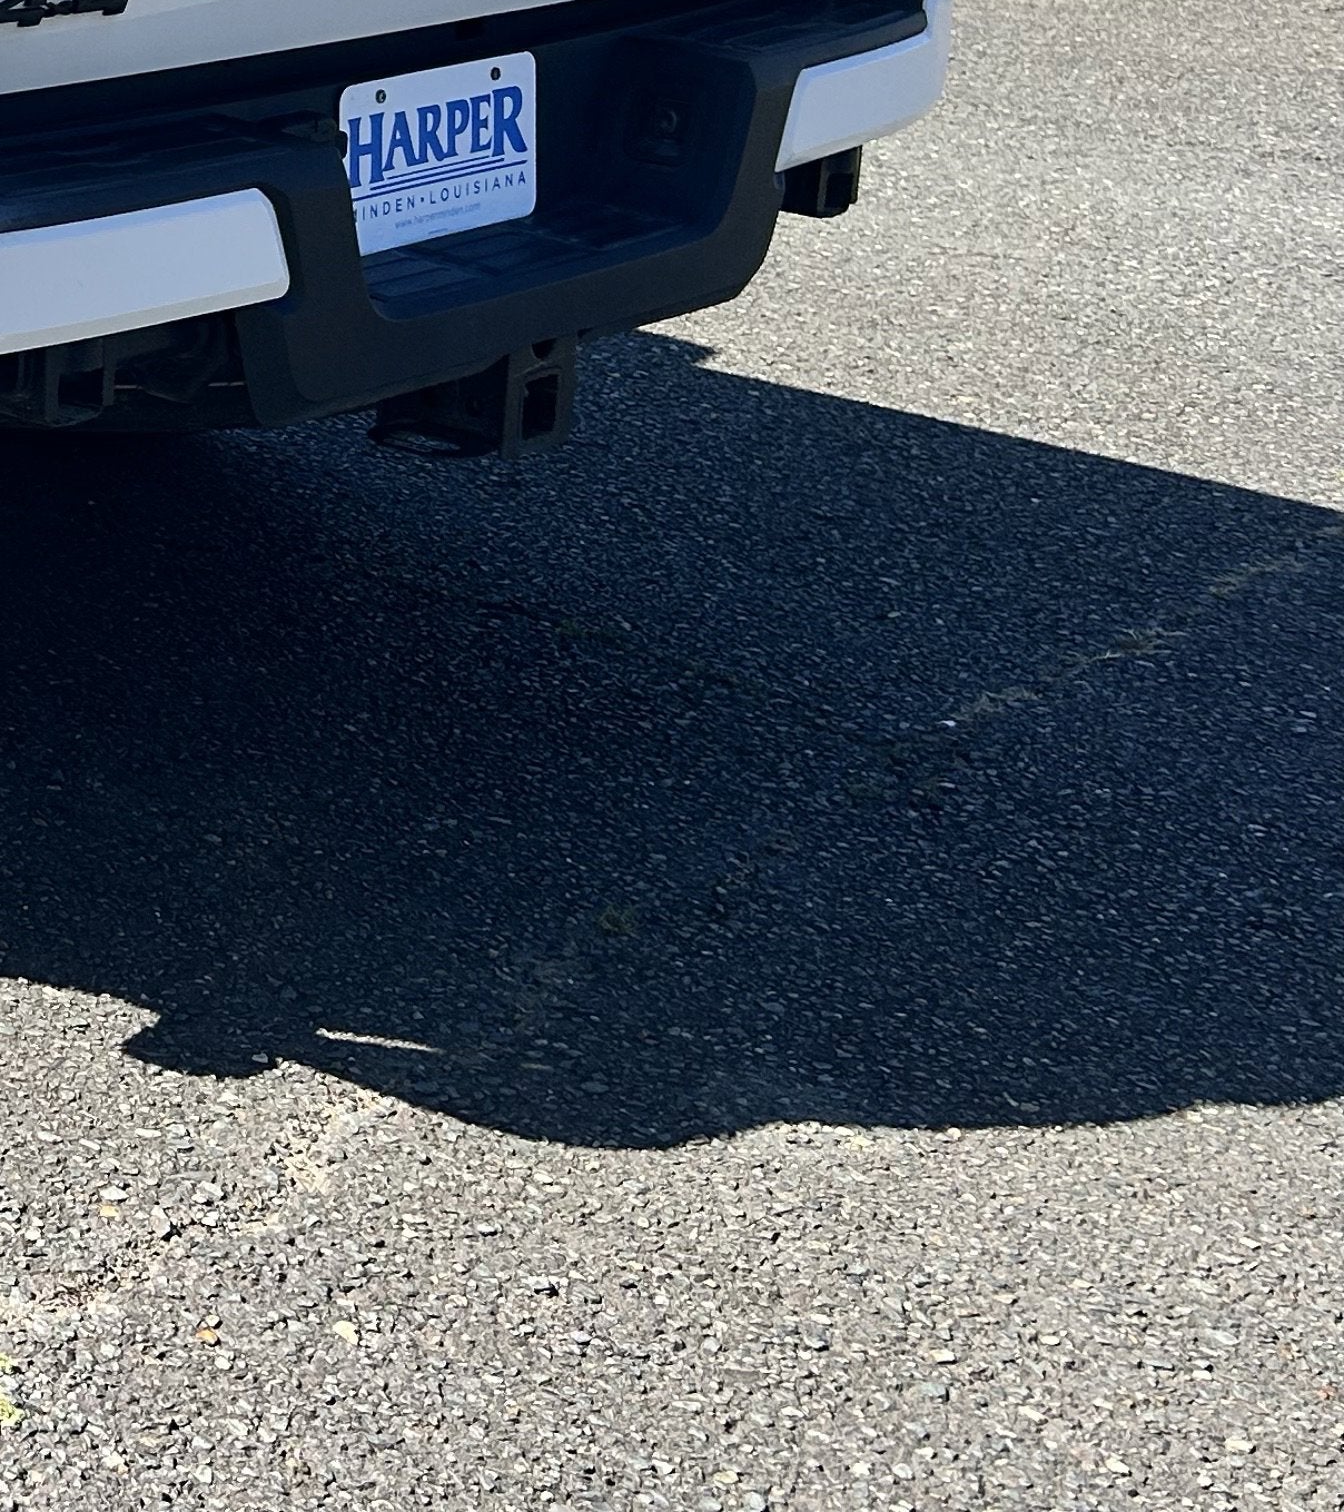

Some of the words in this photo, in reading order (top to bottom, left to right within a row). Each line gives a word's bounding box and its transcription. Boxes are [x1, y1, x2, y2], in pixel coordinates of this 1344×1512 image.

[347, 85, 529, 188] HARPER
[353, 195, 416, 224] INDEN
[429, 170, 527, 205] LOUISIANA
